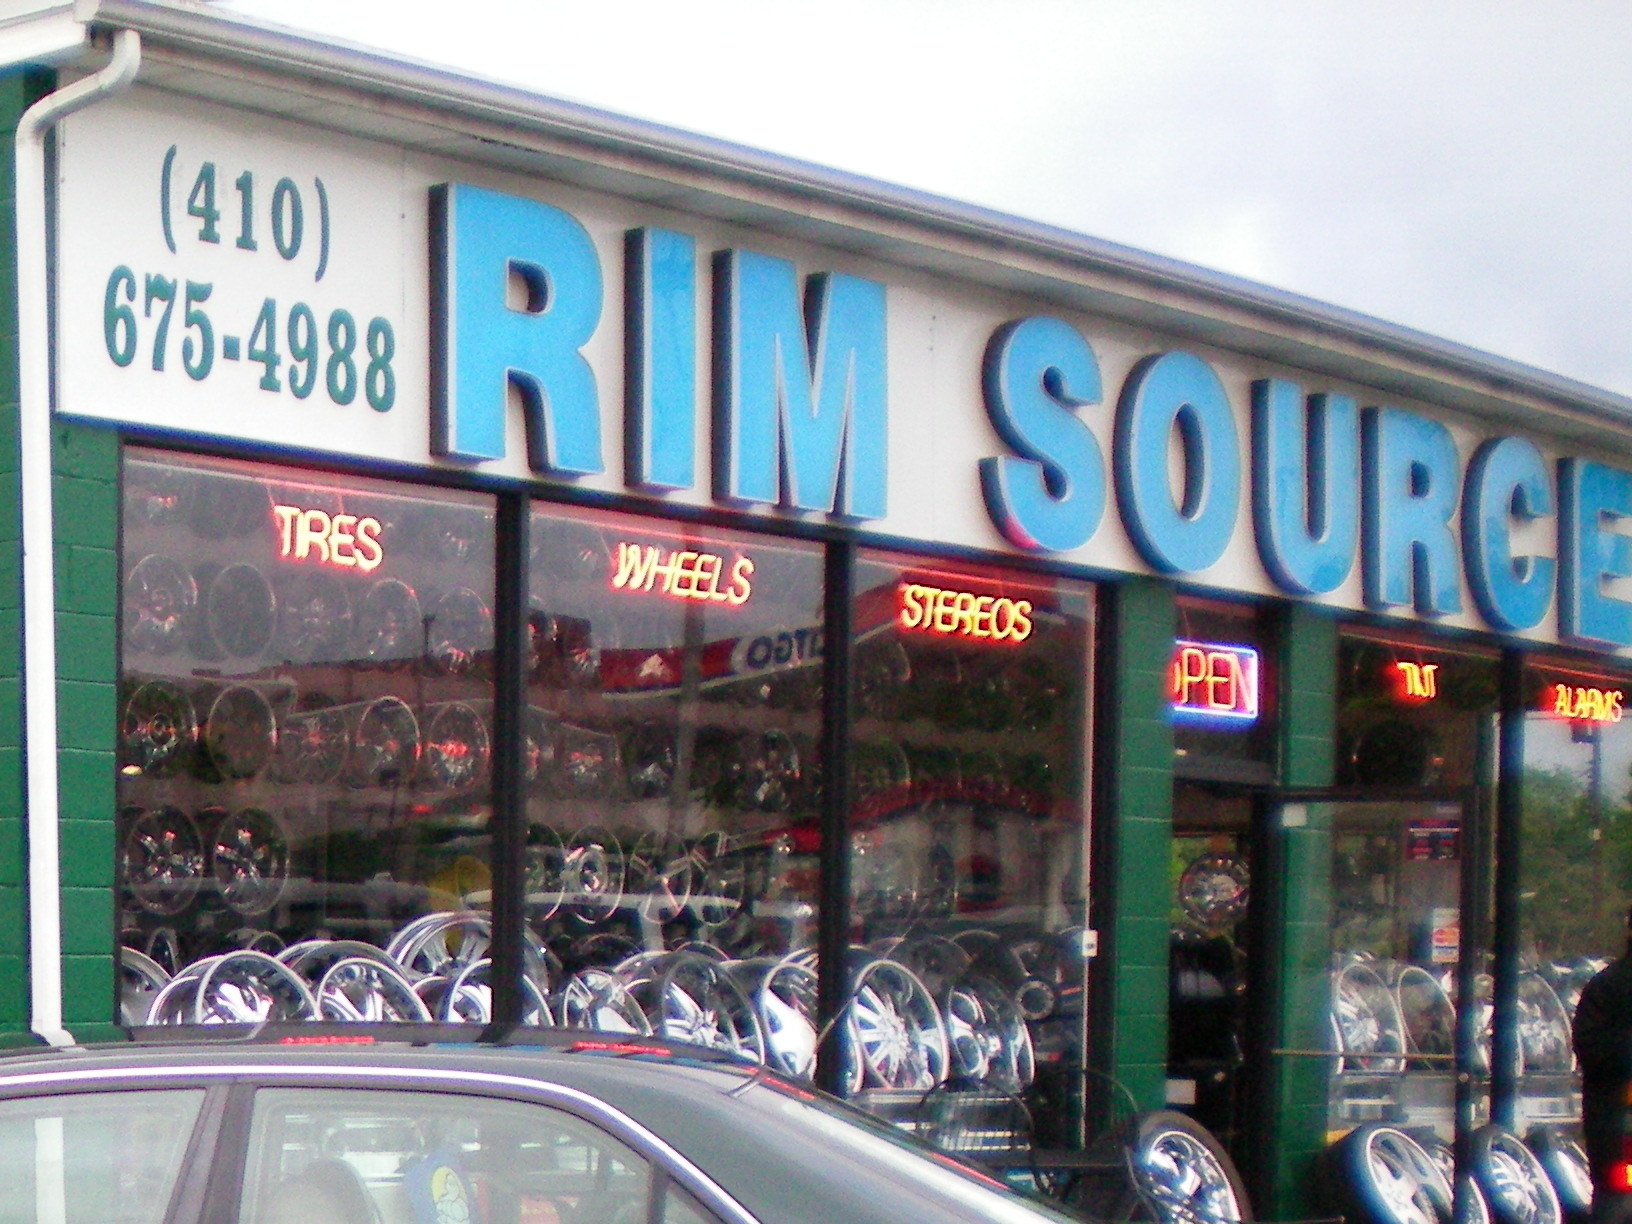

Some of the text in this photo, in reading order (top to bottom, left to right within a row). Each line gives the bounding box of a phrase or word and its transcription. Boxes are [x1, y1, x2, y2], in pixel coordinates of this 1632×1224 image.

[160, 143, 329, 283] (410)
[103, 265, 396, 413] 675-4988
[428, 182, 1632, 656] RIM SOURCE
[274, 504, 383, 573] TIRES
[612, 541, 755, 605] WHEELS
[901, 584, 1033, 642] STEREOS
[1174, 647, 1257, 715] PEN
